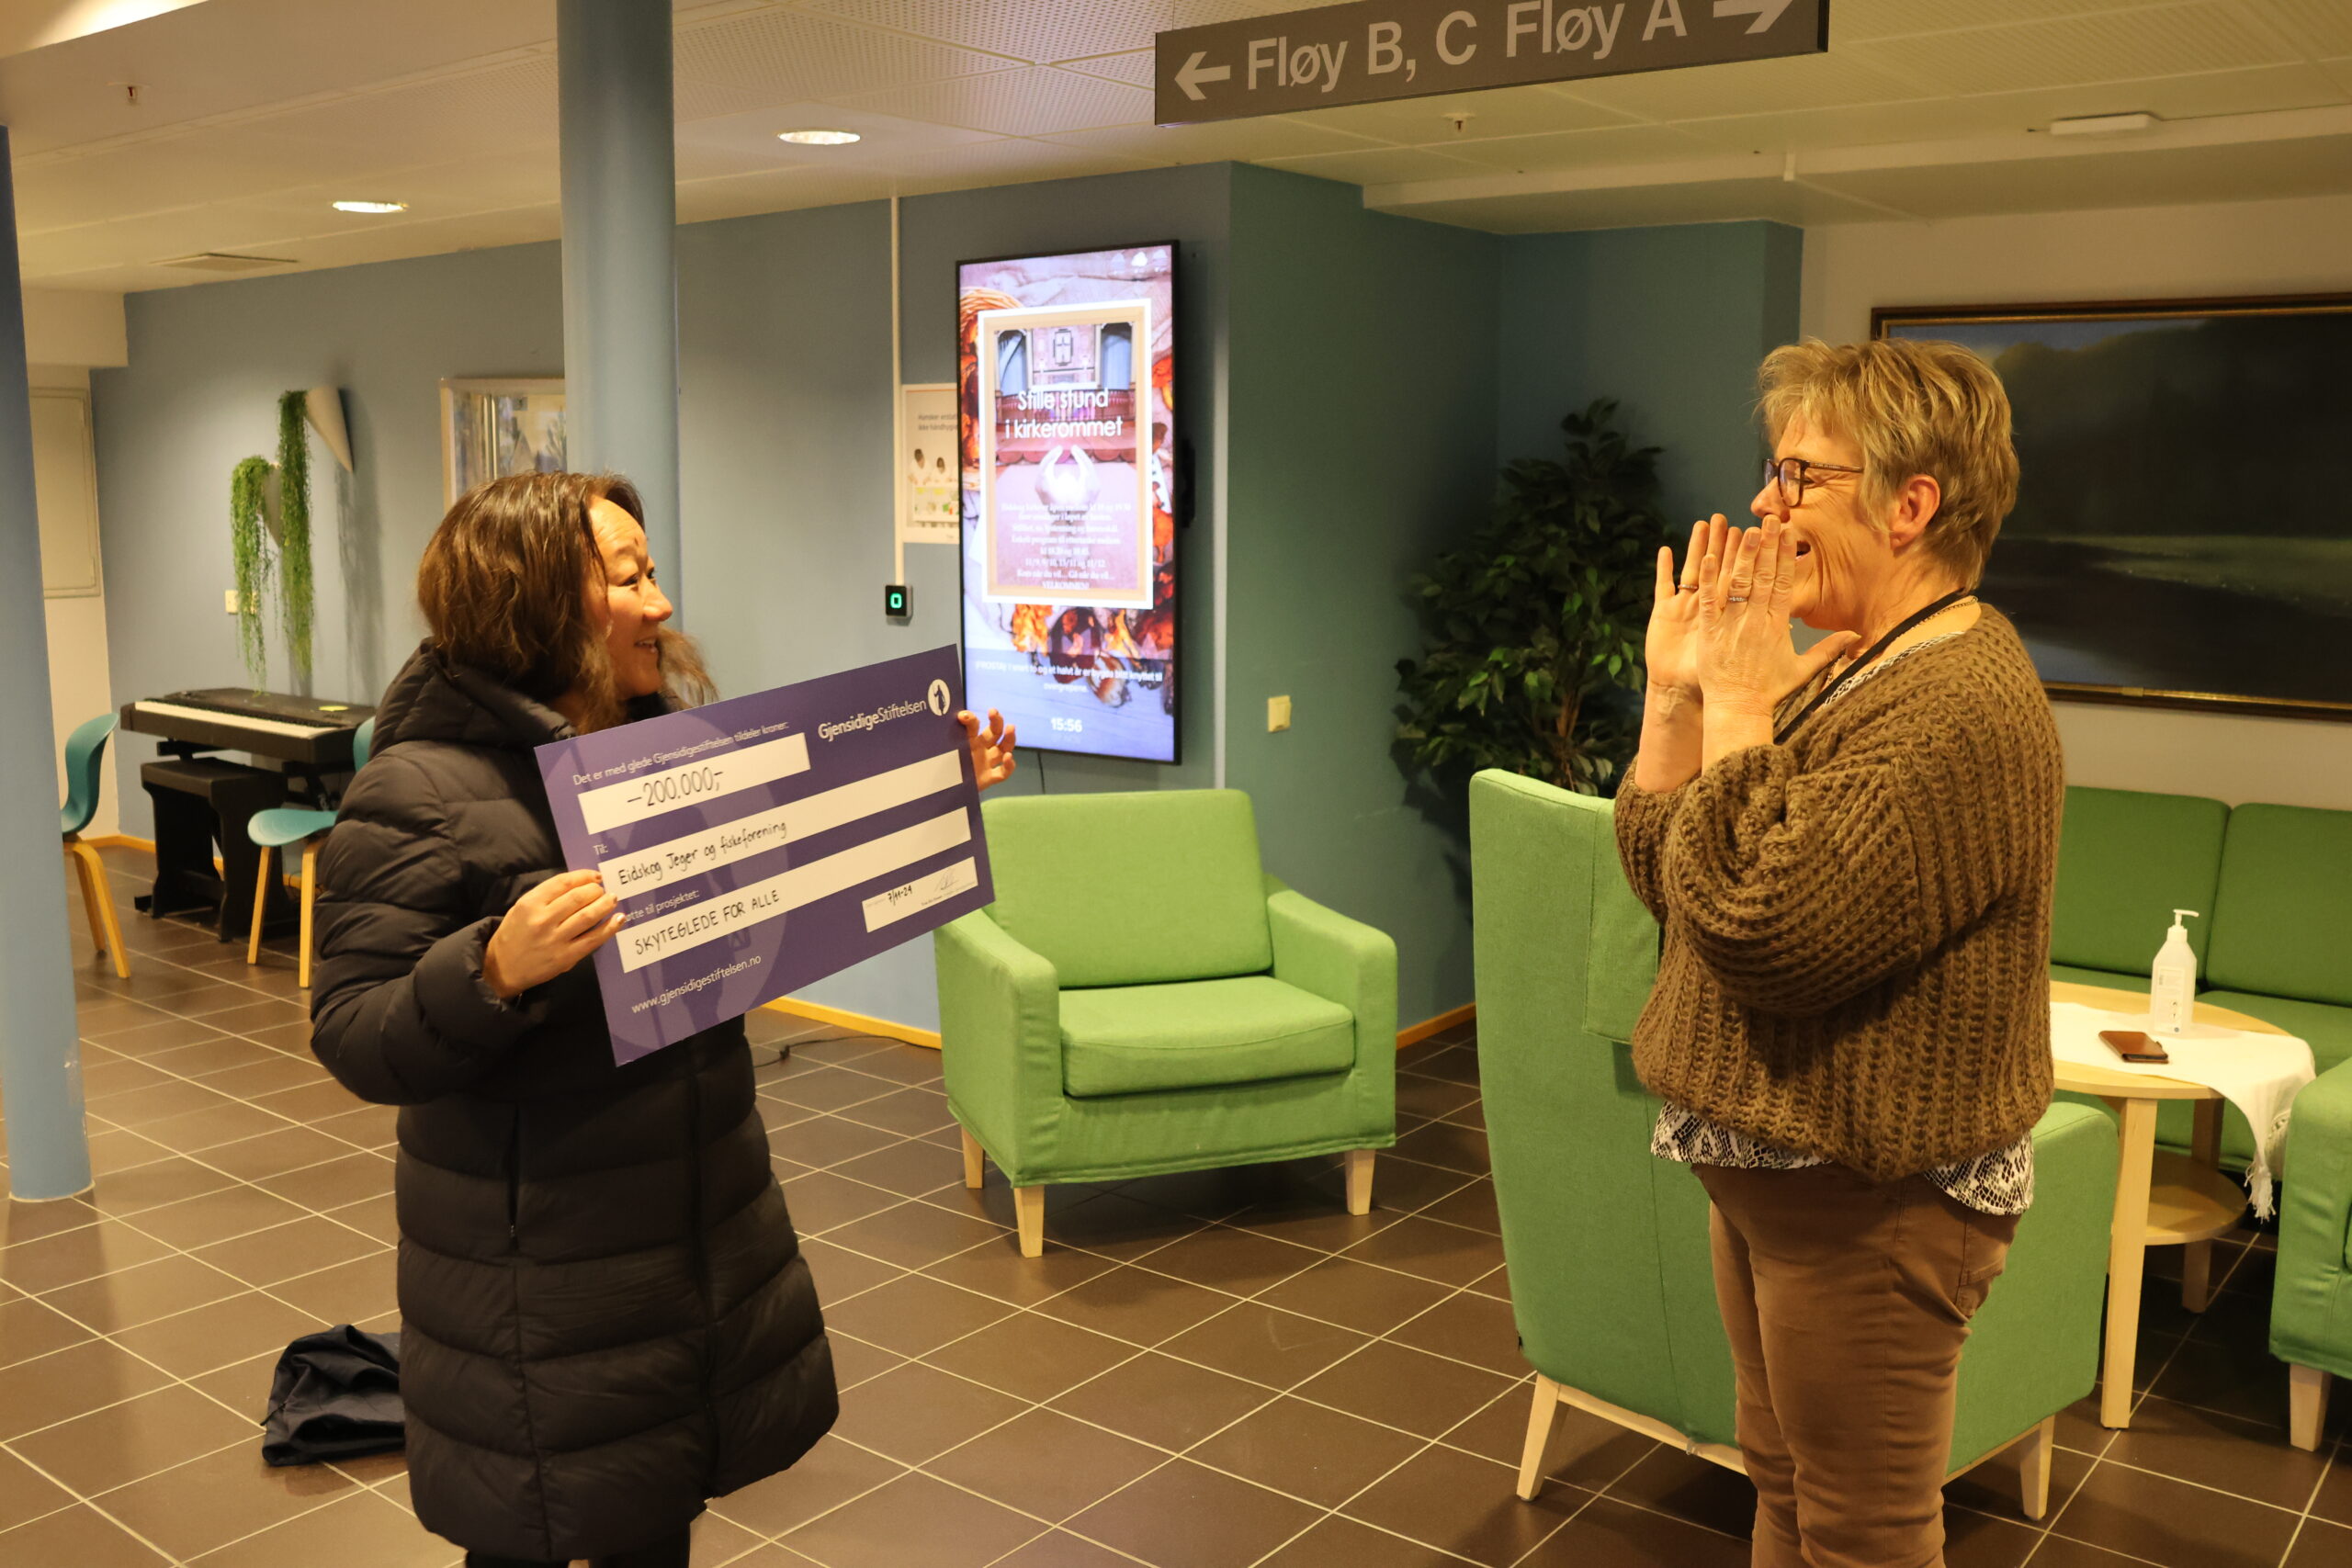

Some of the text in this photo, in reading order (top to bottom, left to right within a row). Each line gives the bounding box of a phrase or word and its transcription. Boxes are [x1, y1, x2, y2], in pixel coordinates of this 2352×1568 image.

[1248, 0, 1688, 93] Fløy B, C Fløy A
[1017, 388, 1109, 411] Stille stund
[1005, 416, 1123, 439] i kirkerommet
[818, 700, 927, 742] GjensidigeStiftelsen
[1051, 717, 1083, 733] 15:56
[573, 773, 593, 785] Det
[593, 771, 604, 780] er
[605, 762, 627, 777] med
[628, 756, 652, 773] glede
[652, 736, 734, 765] Gjensidigestiftelsen
[734, 728, 761, 742] tildeler
[593, 843, 609, 855] Til:
[618, 861, 662, 885] Eidskog
[666, 848, 698, 872] Jeger
[704, 844, 717, 861] og
[635, 889, 780, 955] SKYTEGLEDE FOR ALLE
[645, 904, 655, 915] til
[655, 889, 699, 914] prosjektet:
[631, 955, 763, 1013] www.gjensidigestiftelsen.no
